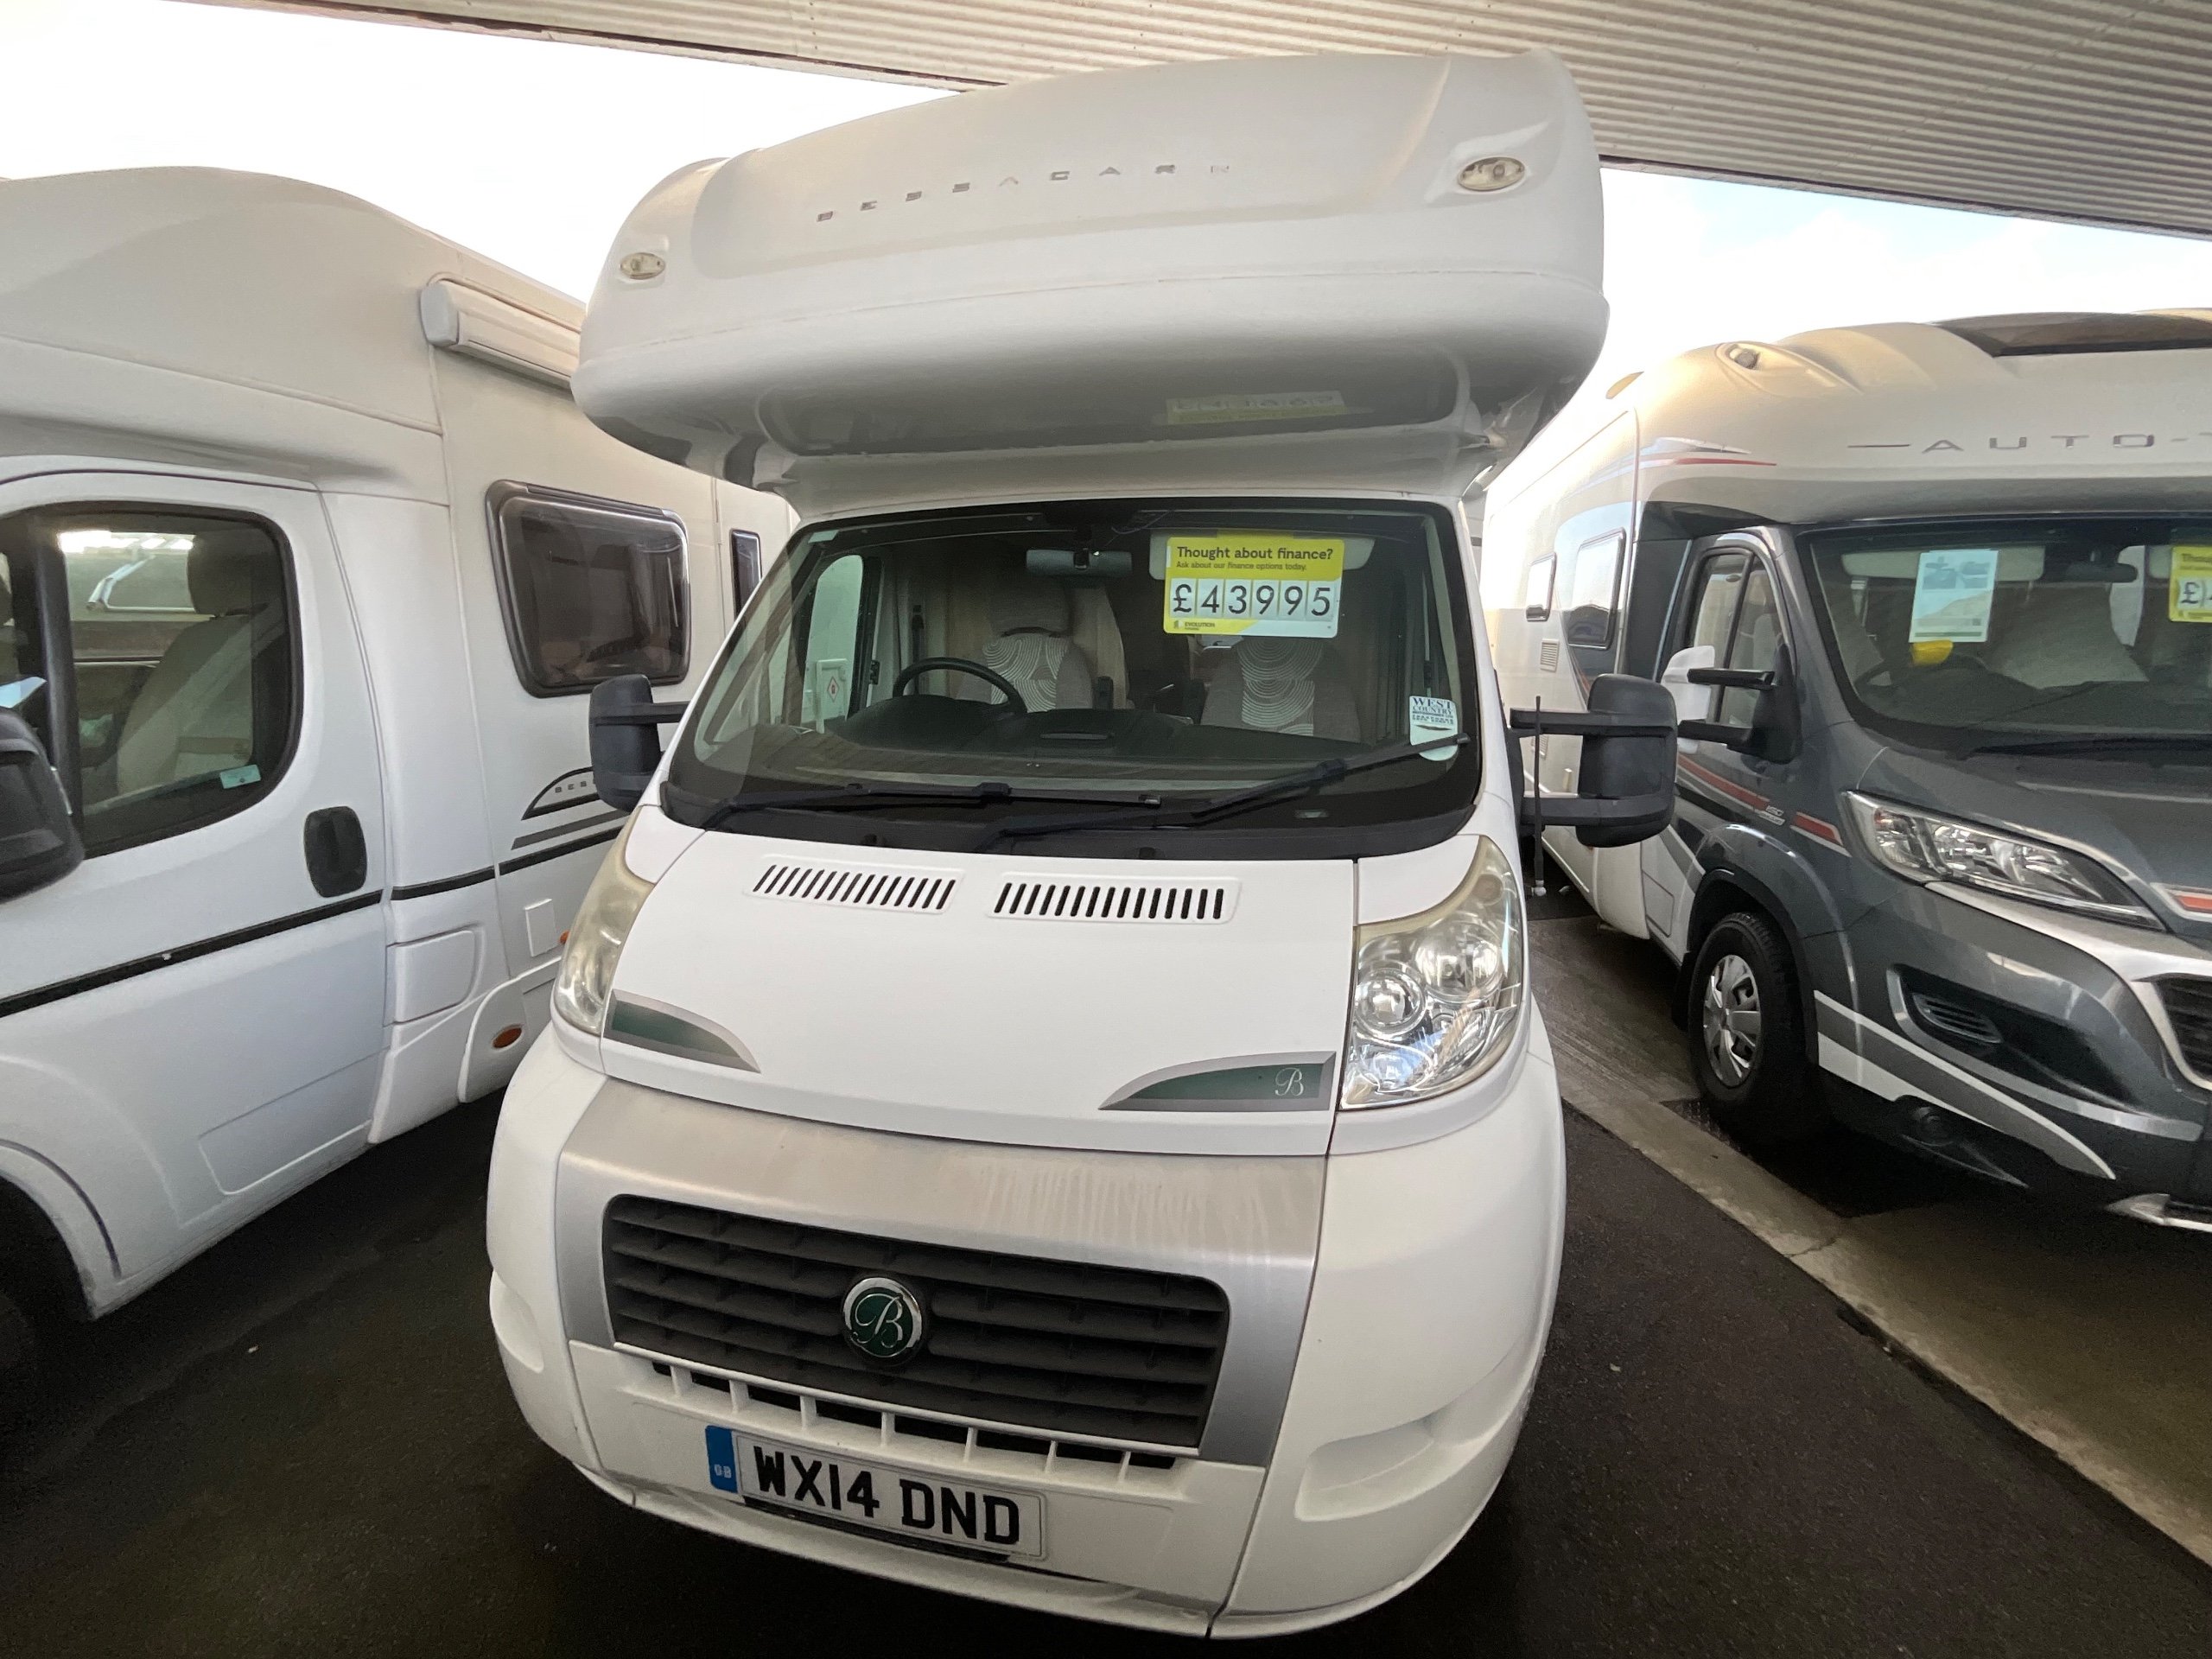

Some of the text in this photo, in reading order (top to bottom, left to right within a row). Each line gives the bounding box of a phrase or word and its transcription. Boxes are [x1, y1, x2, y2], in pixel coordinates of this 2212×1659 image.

[1176, 546, 1334, 561] Thought about finance?
[1173, 583, 1332, 617] £43995
[1412, 696, 1452, 709] WEST
[1412, 705, 1452, 715] COUNTRY
[555, 780, 596, 793] BES
[1274, 1067, 1304, 1096] B
[853, 1293, 903, 1348] B
[753, 1445, 1020, 1545] WX14 DND
